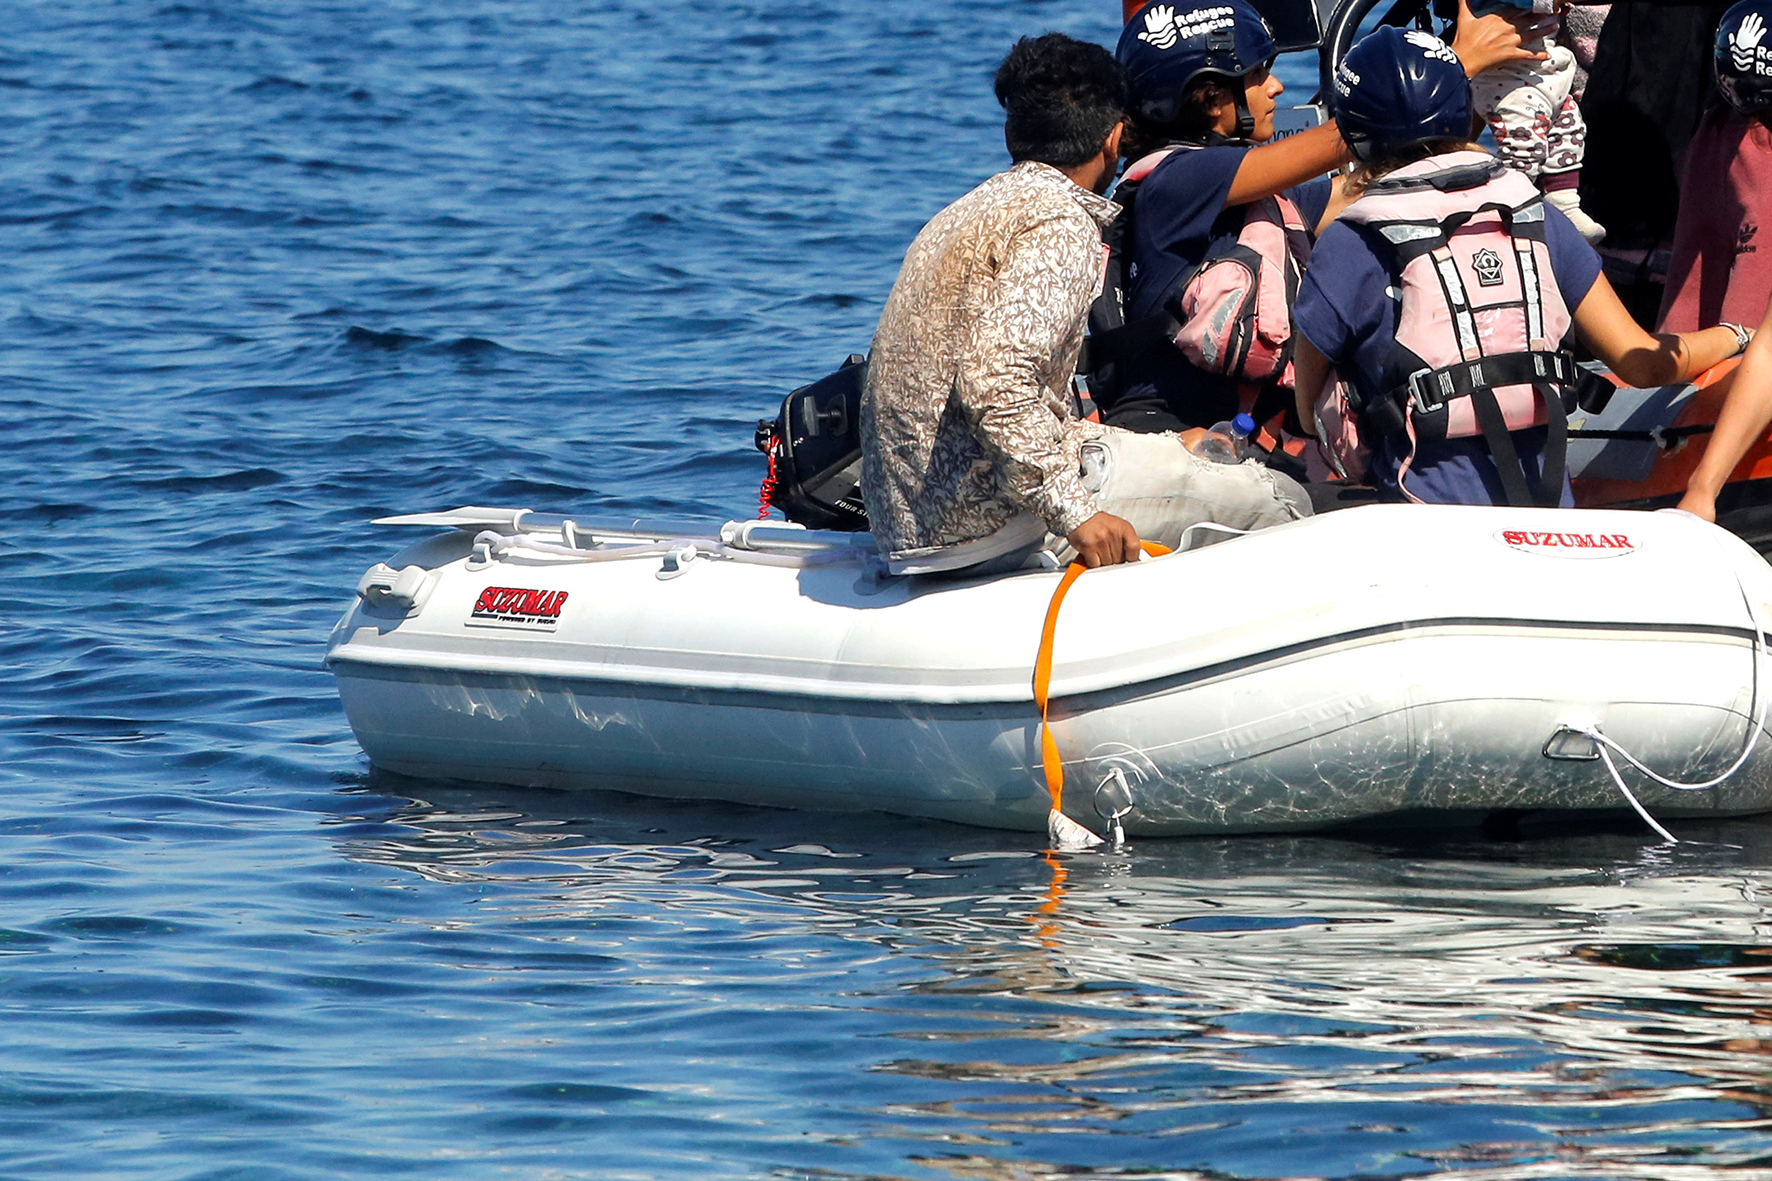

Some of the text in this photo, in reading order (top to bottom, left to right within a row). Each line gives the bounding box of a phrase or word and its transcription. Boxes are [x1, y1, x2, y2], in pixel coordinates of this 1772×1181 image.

[1174, 6, 1234, 28] Refugee
[1179, 17, 1235, 40] Rescue
[1502, 530, 1635, 549] SUZUMAR
[474, 586, 569, 618] SUZUMAR
